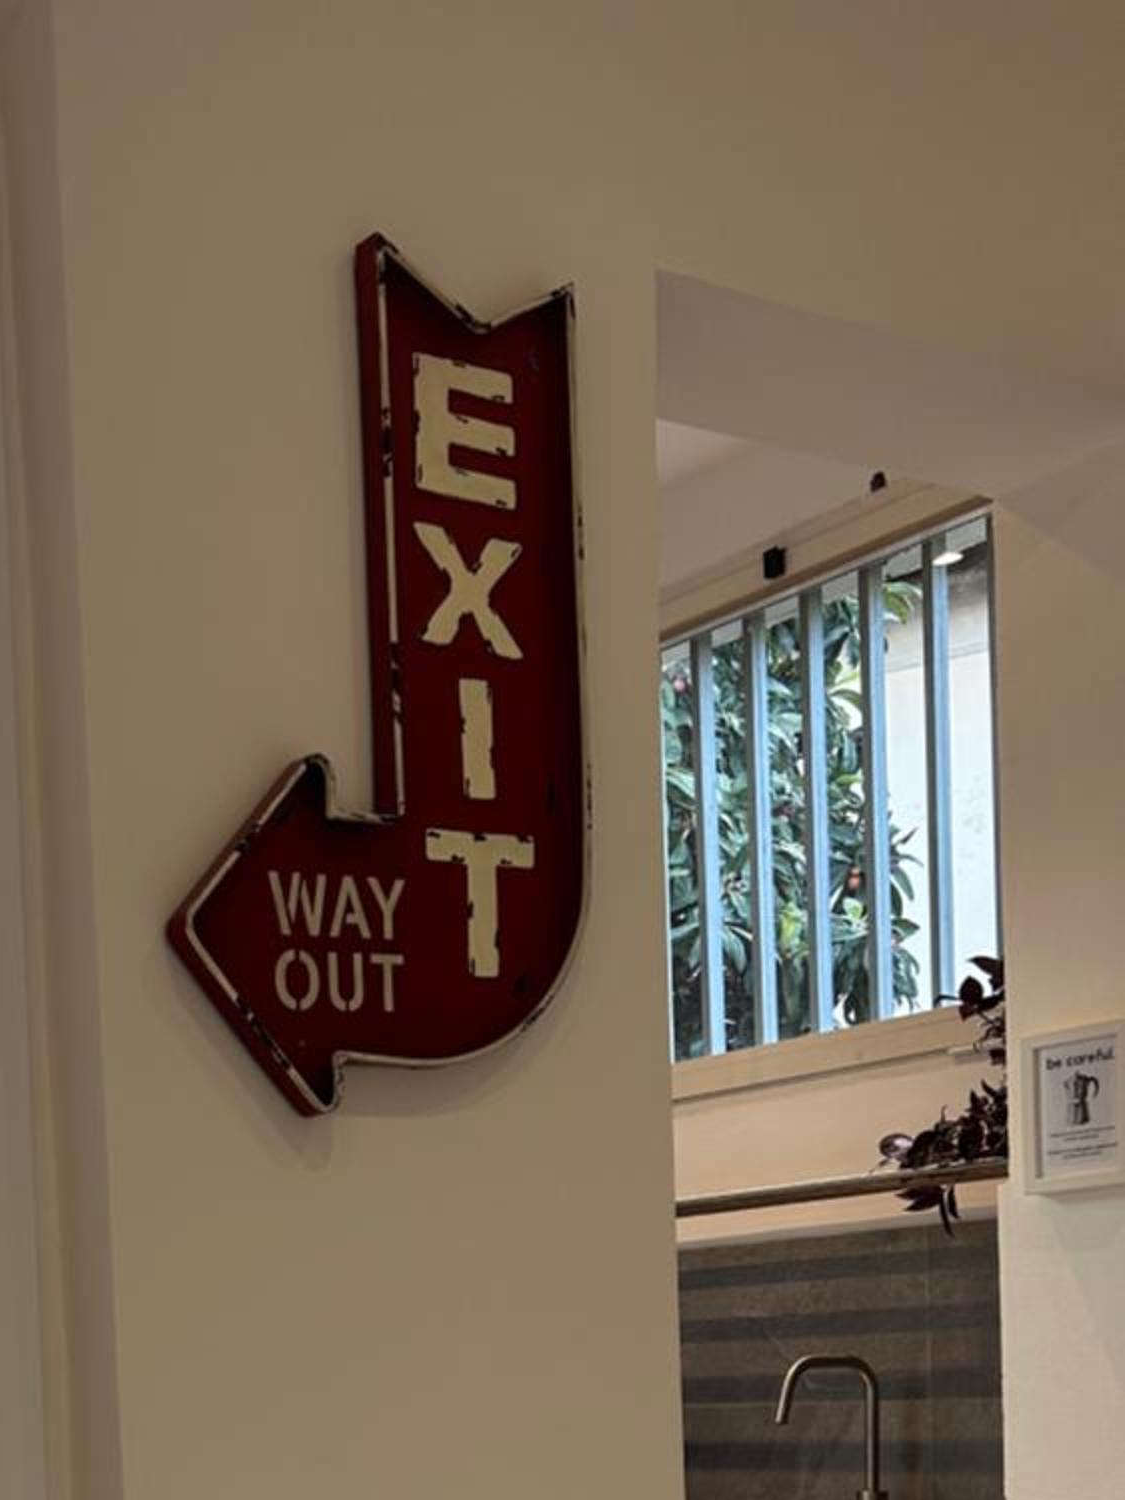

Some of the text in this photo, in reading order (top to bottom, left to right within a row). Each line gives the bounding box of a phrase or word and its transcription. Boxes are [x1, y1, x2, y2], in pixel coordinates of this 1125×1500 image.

[412, 351, 535, 978] EXIT
[269, 870, 406, 942] WAY
[275, 949, 405, 1013] OUT
[1046, 1057, 1062, 1070] be
